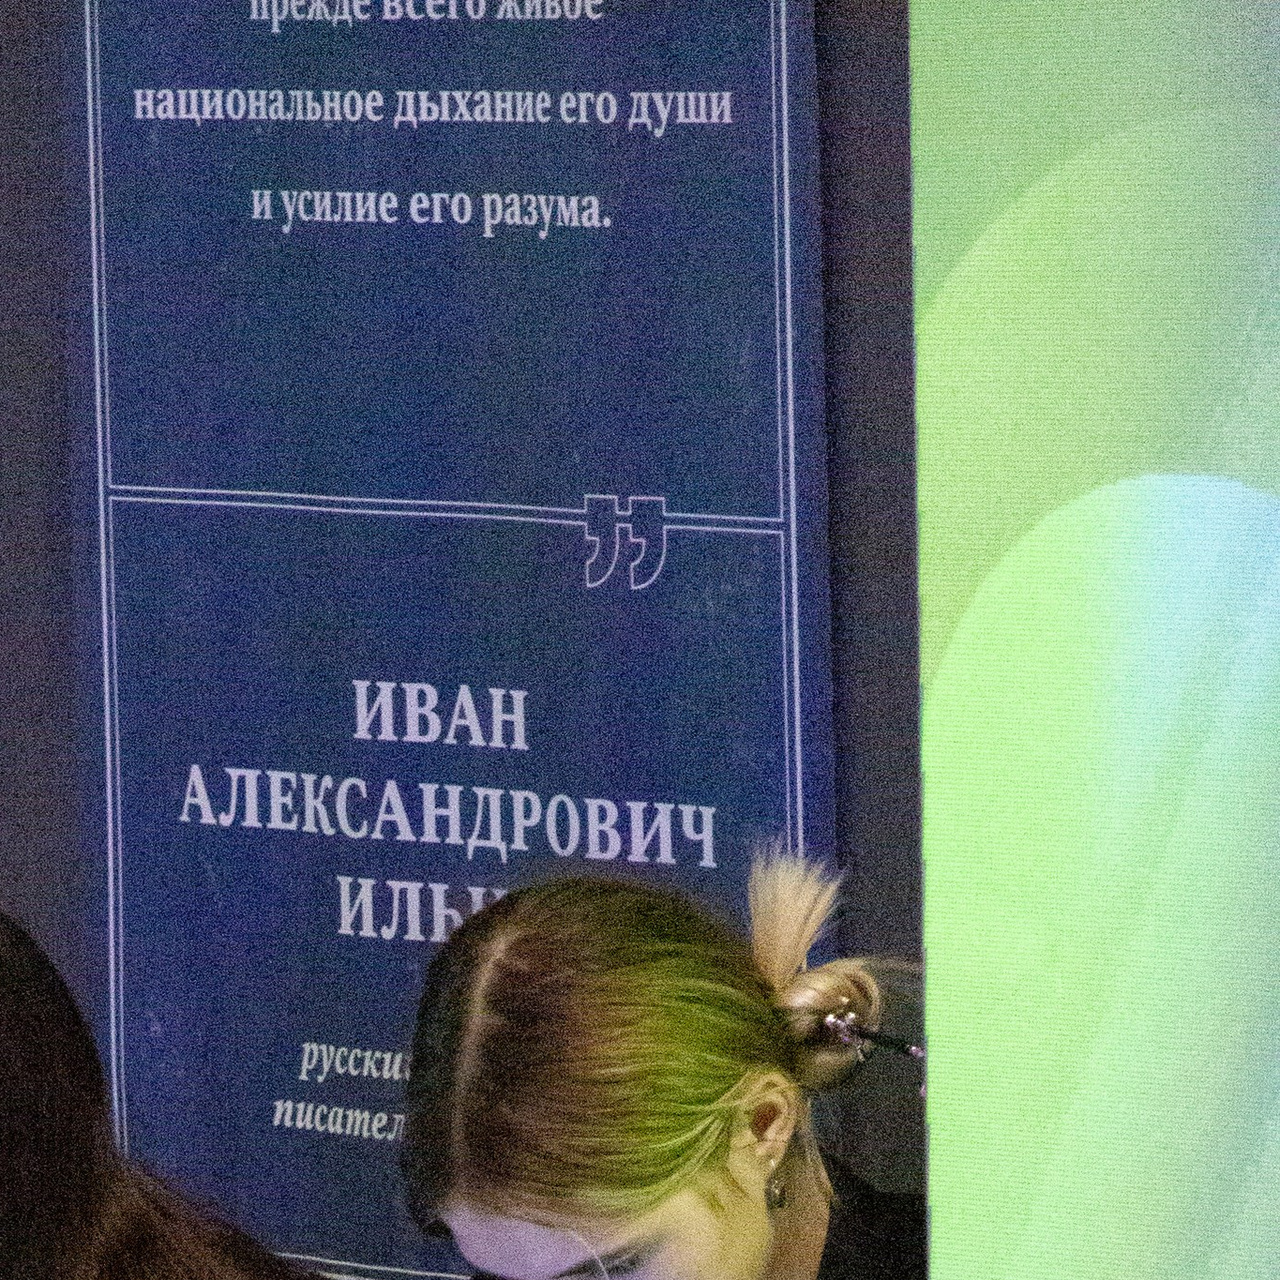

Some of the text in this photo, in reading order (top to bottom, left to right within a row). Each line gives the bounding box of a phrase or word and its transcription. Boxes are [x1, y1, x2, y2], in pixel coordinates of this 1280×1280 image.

[250, 0, 603, 34] прежде всего живое
[134, 89, 732, 138] национальное дыхание его души
[252, 190, 611, 239] и усилие его разума.
[353, 680, 528, 750] ИВАН
[180, 764, 716, 868] АЛЕКСАНДРОВИЧ
[299, 1042, 409, 1083] русски
[273, 1100, 405, 1141] писател
